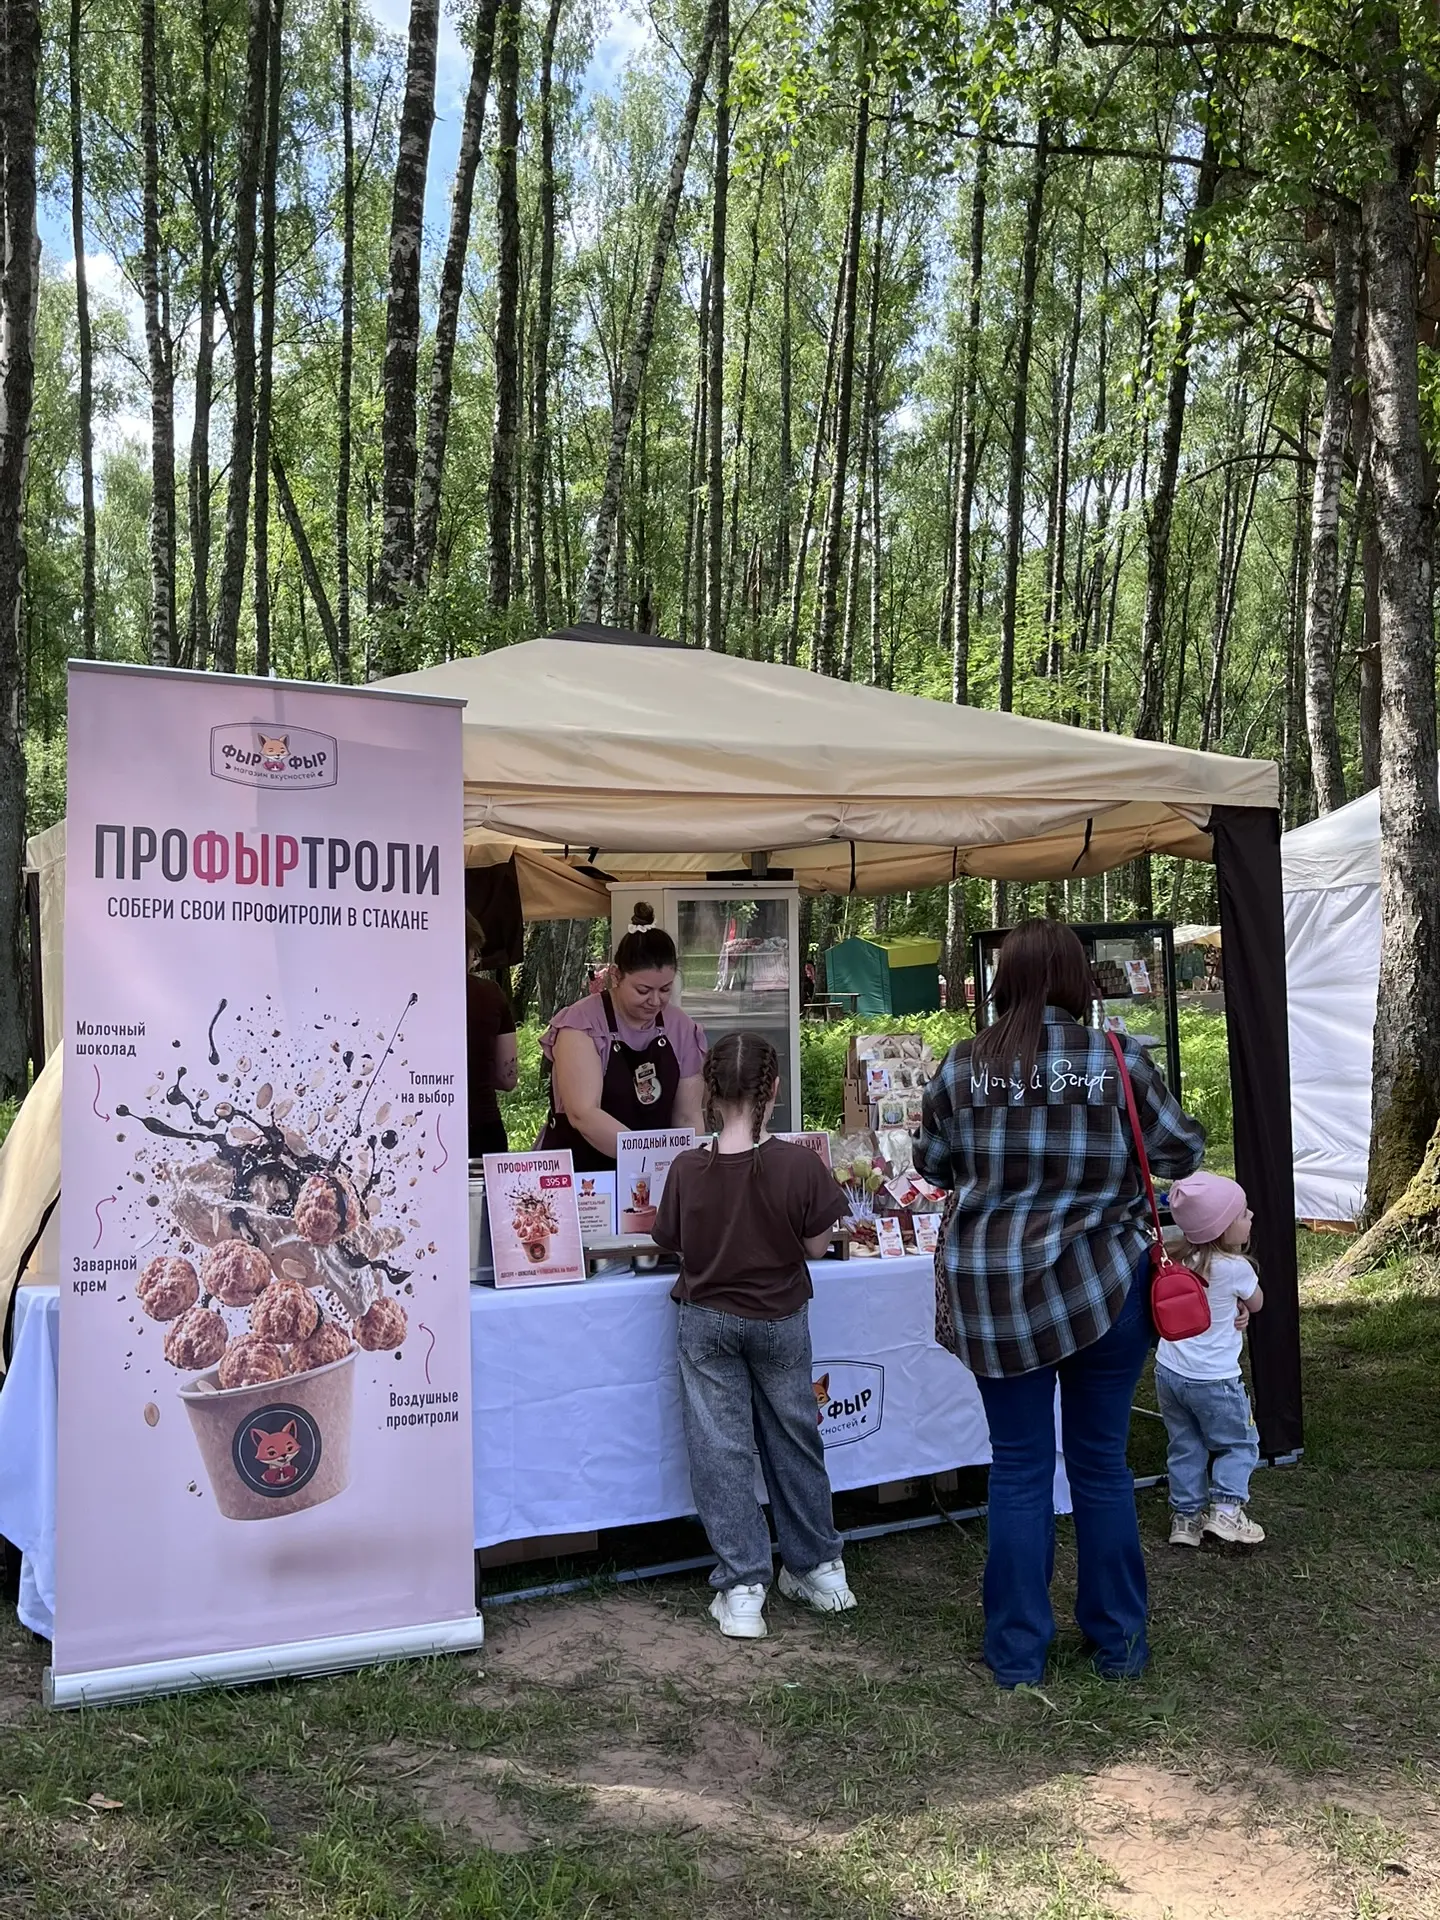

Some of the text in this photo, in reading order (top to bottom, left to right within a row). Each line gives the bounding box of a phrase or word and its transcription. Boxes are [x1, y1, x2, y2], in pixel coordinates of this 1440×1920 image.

[222, 744, 327, 770] ФЫР ФЫР
[233, 766, 316, 781] магазин вкусностей
[95, 824, 440, 896] ПРОФЫРТРОЛИ
[108, 897, 429, 930] СОБЕРИ СВОИ ПРОФИТРОЛИ В СТАКАНЕ
[76, 1020, 146, 1036] Молочный
[76, 1043, 137, 1058] шоколад
[409, 1071, 455, 1085] Топпинг
[1050, 1059, 1114, 1099] Script
[401, 1089, 455, 1107] на выбор
[621, 1134, 691, 1151] ХОЛОДНЫЙ КОФЕ
[497, 1159, 560, 1174] ПРОФЫРТРОЛИ
[545, 1177, 561, 1187] 395
[73, 1255, 137, 1275] Заварной
[73, 1280, 107, 1296] крем
[389, 1391, 459, 1409] Воздушные
[828, 1389, 871, 1419] ФЫР
[386, 1411, 459, 1430] профитроли
[819, 1419, 858, 1436] сностей
